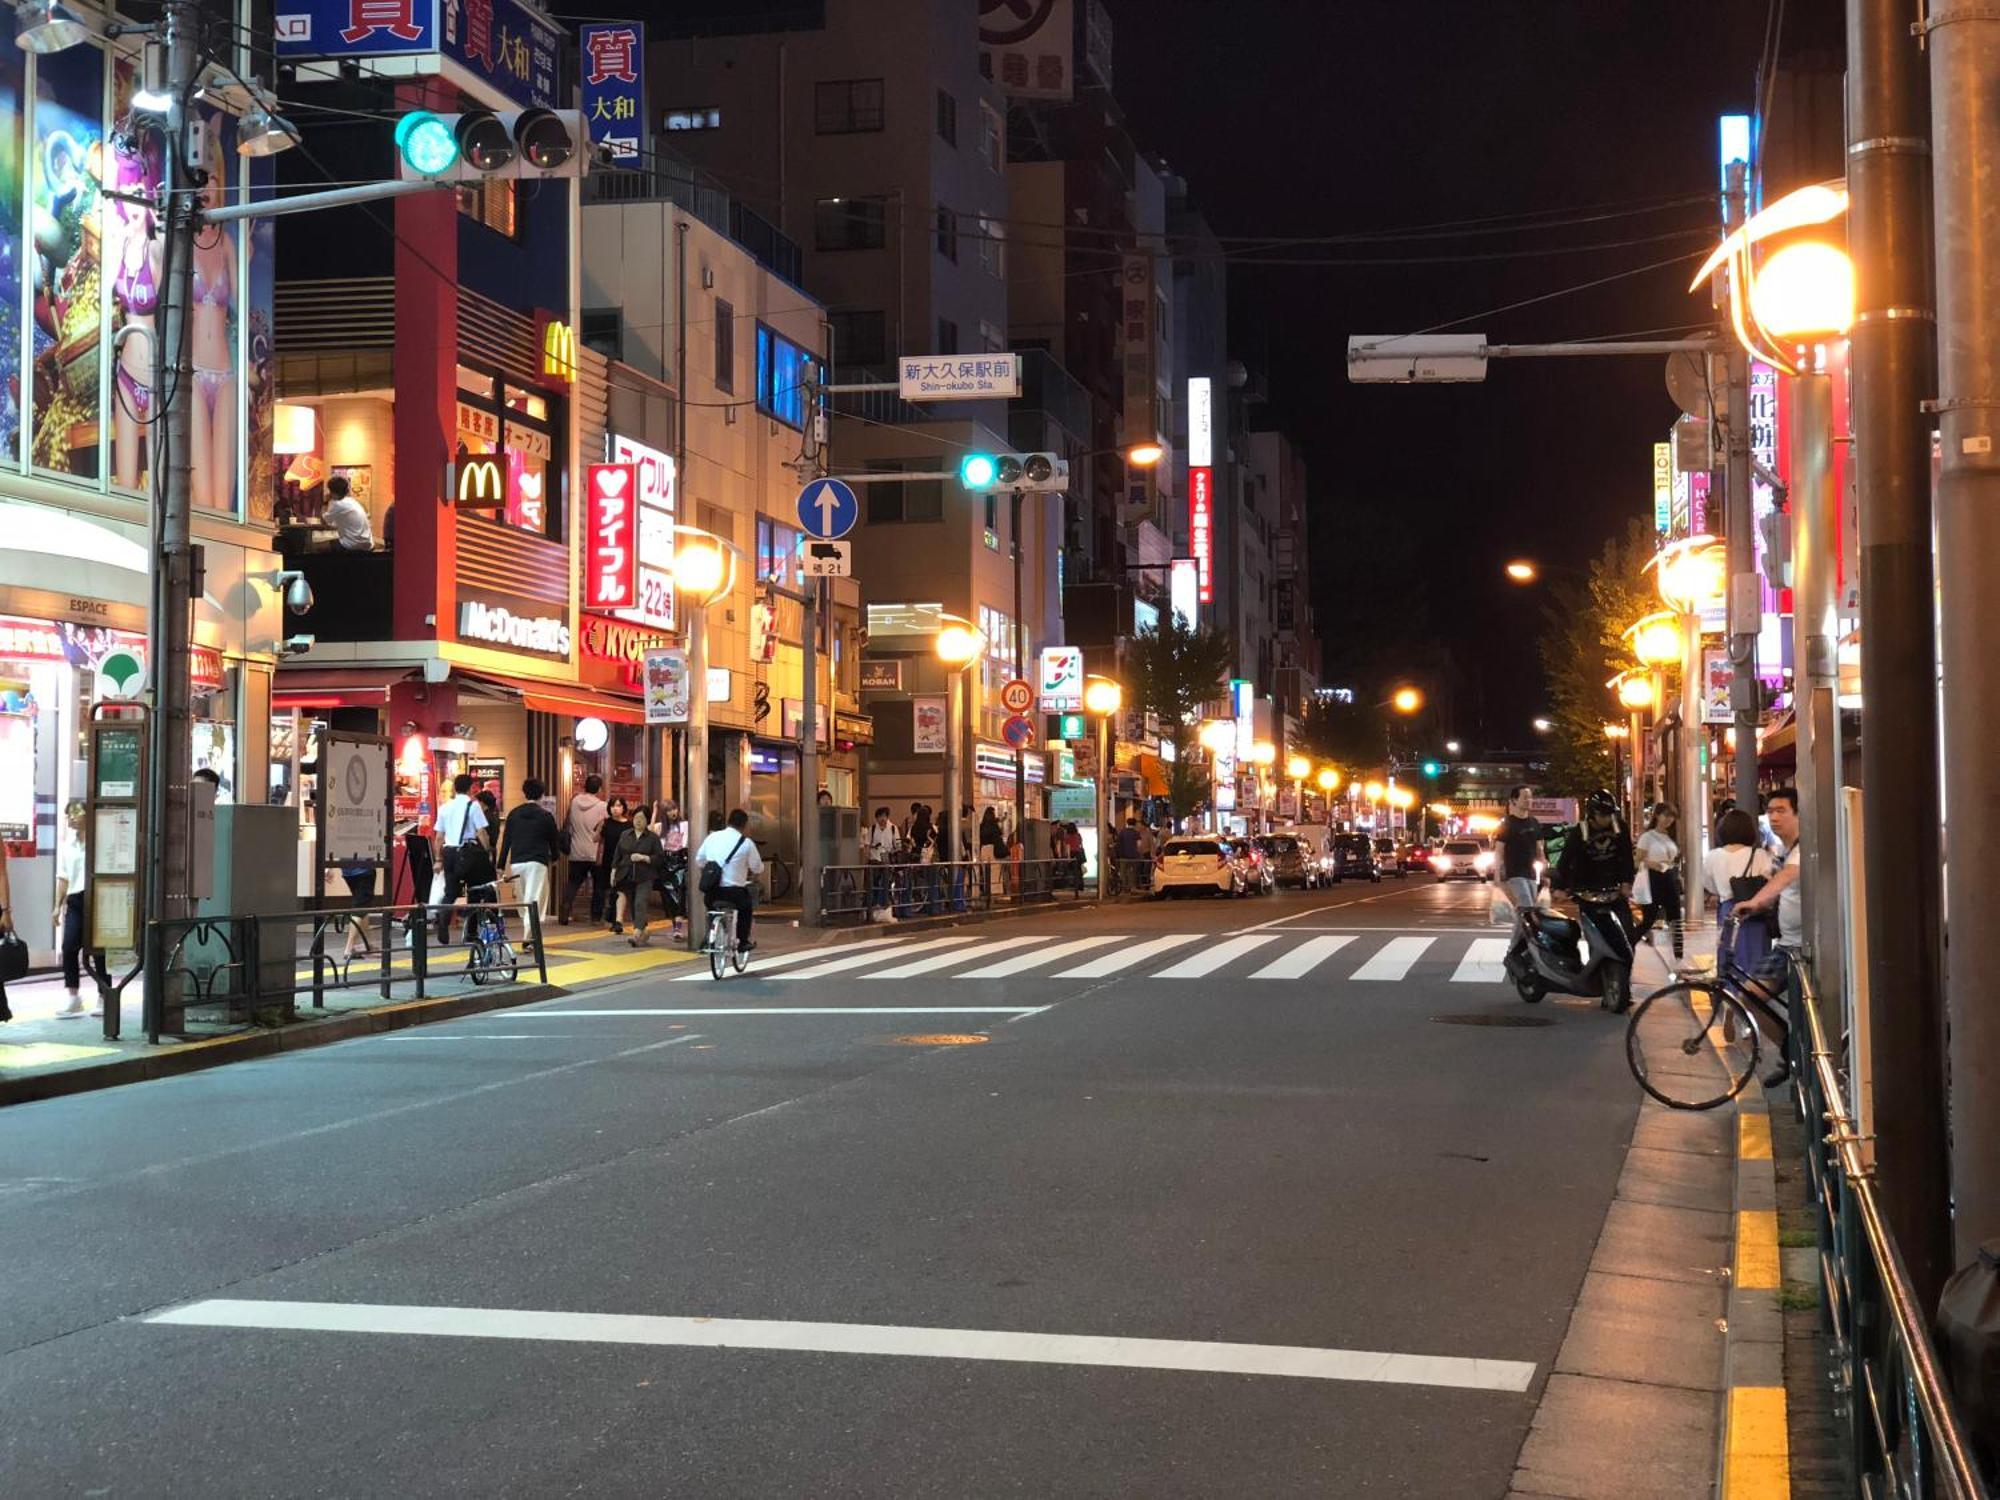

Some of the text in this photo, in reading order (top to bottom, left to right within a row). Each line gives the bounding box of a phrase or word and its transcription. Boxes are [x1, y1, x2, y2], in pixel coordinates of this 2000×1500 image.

[498, 25, 530, 81] 大和
[587, 29, 638, 85] 質
[590, 96, 635, 121] 大和
[905, 361, 1010, 380] 新大久保駅前
[598, 498, 626, 602] アイフル
[70, 599, 107, 616] ESPACE
[1009, 689, 1028, 704] 40
